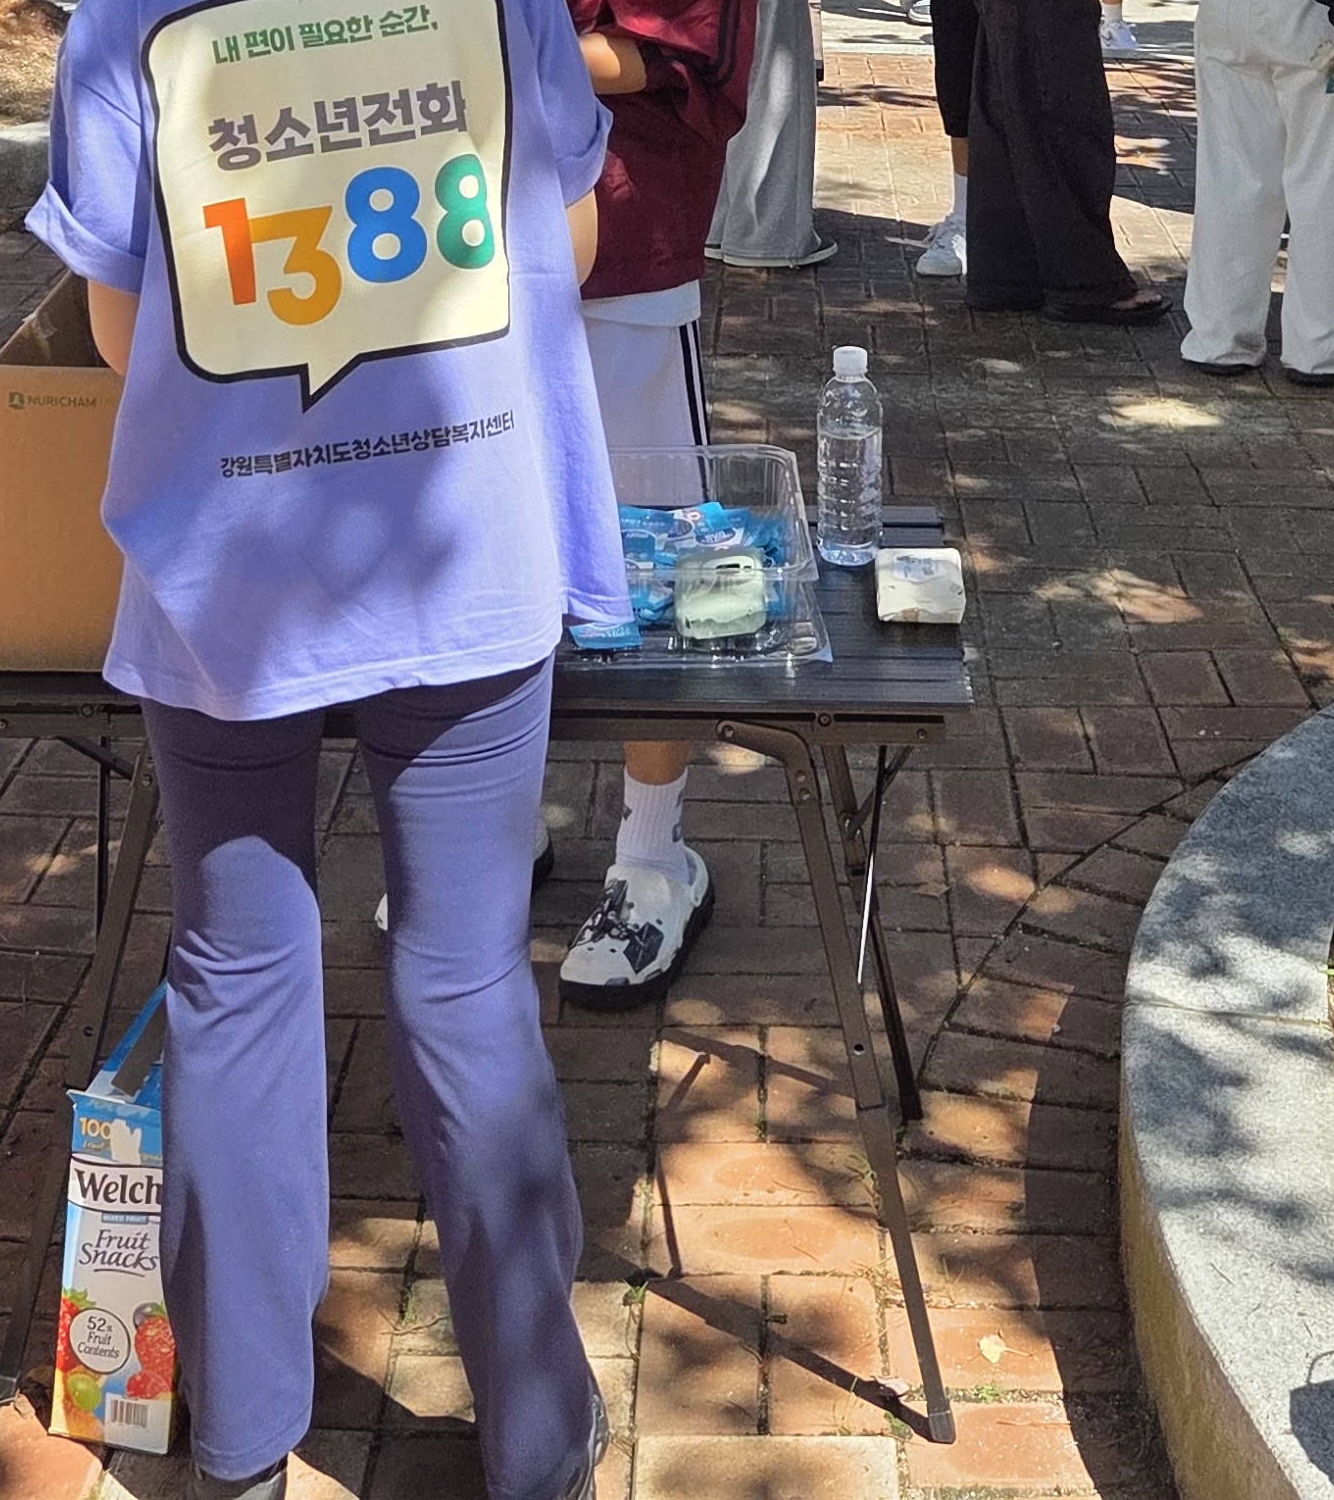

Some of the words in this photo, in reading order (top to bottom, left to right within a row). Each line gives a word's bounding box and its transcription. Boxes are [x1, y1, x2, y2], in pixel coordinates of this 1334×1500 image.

[213, 36, 242, 64] 내
[245, 24, 295, 60] 편이
[298, 16, 372, 49] 필요한
[378, 4, 439, 39] 순간,
[208, 79, 469, 171] 청소년전화
[203, 152, 496, 327] 1388
[27, 395, 97, 408] NURICHAM
[220, 410, 516, 478] 강원특별자치도청소년상담복지센터
[74, 1167, 163, 1205] Welch
[94, 1228, 152, 1250] Fruit
[78, 1242, 159, 1272] Snacks
[77, 1342, 121, 1359] Contents
[87, 1332, 112, 1345] Fruit
